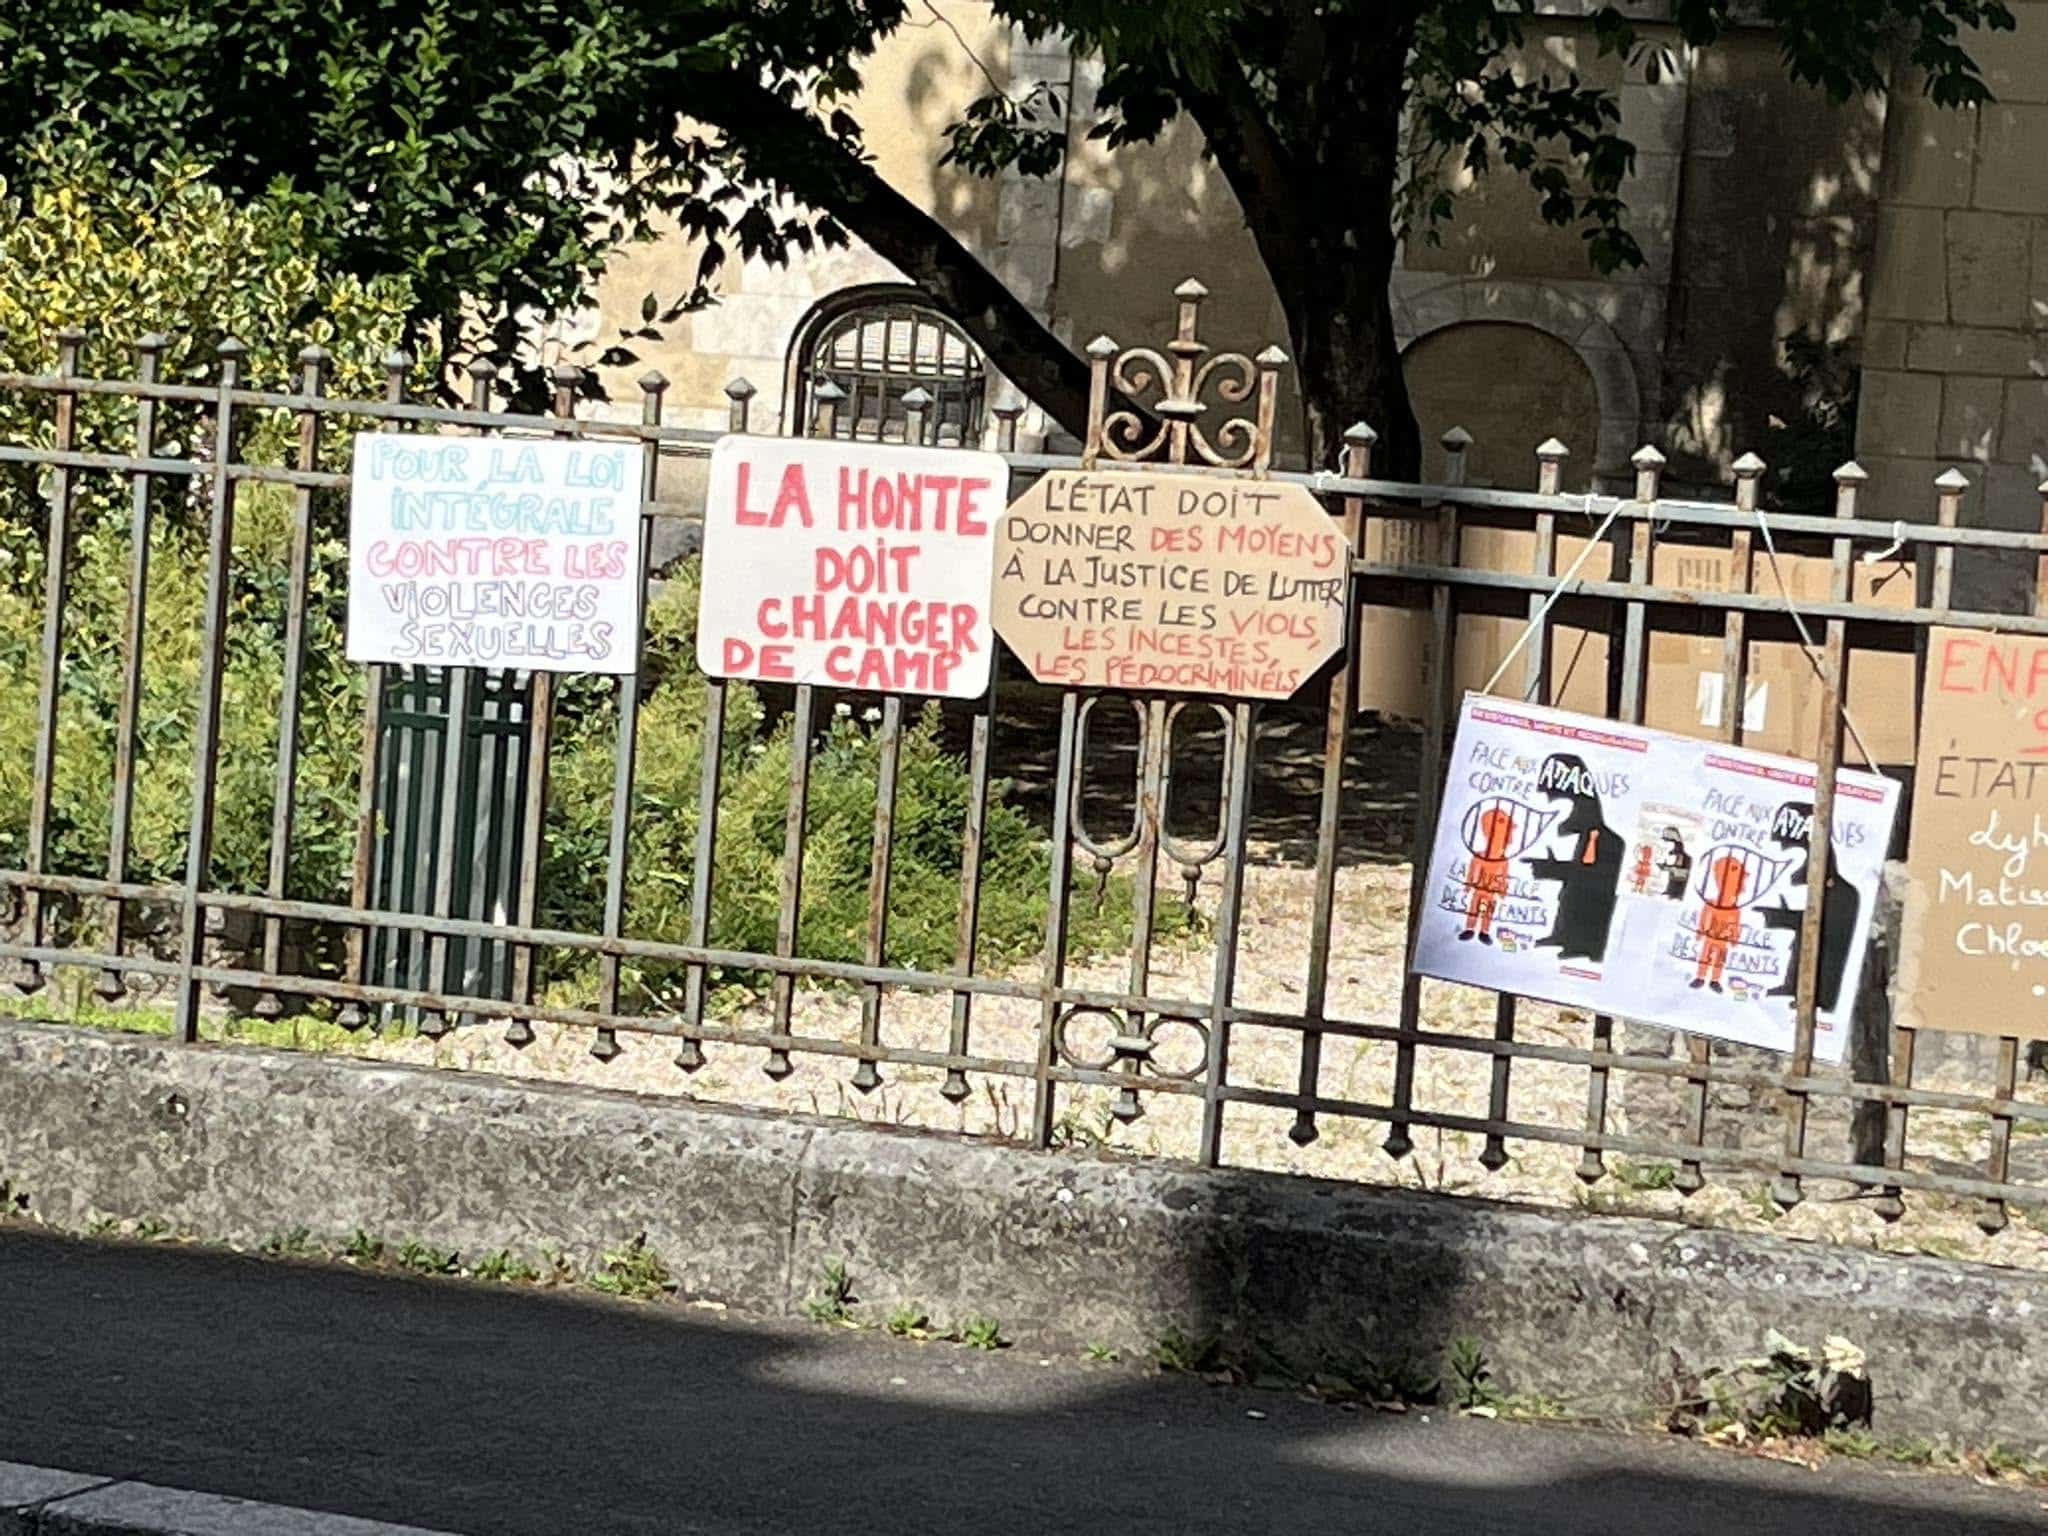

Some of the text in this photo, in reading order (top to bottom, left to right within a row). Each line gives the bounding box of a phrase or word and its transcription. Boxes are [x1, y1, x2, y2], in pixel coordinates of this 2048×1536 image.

[370, 438, 626, 492] POUR LA LOI
[390, 481, 615, 536] INTÉGRALE
[735, 462, 992, 536] LA HONTE
[1045, 477, 1281, 518] L'ÉTAT DOIT
[366, 537, 629, 580] CONTRE LES
[816, 537, 921, 594] DOIT
[1007, 517, 1337, 568] DONNER DES MOYENS
[382, 580, 600, 622] VIOLENCES
[1002, 546, 1344, 609] À LA JUSTICE DE LUTTER
[390, 621, 613, 661] SEXUELLES
[757, 596, 979, 653] CHANGER
[1018, 593, 1320, 651] CONTRE LES VIOLS,
[1062, 624, 1281, 669] LES INCESTES,
[723, 637, 962, 691] DE CAMP
[1034, 652, 1087, 683] LES
[1469, 740, 1511, 770] FACE
[1934, 738, 2048, 799] ÉTAT
[1468, 771, 1535, 801] CONTRE
[1702, 788, 1744, 818] FACE
